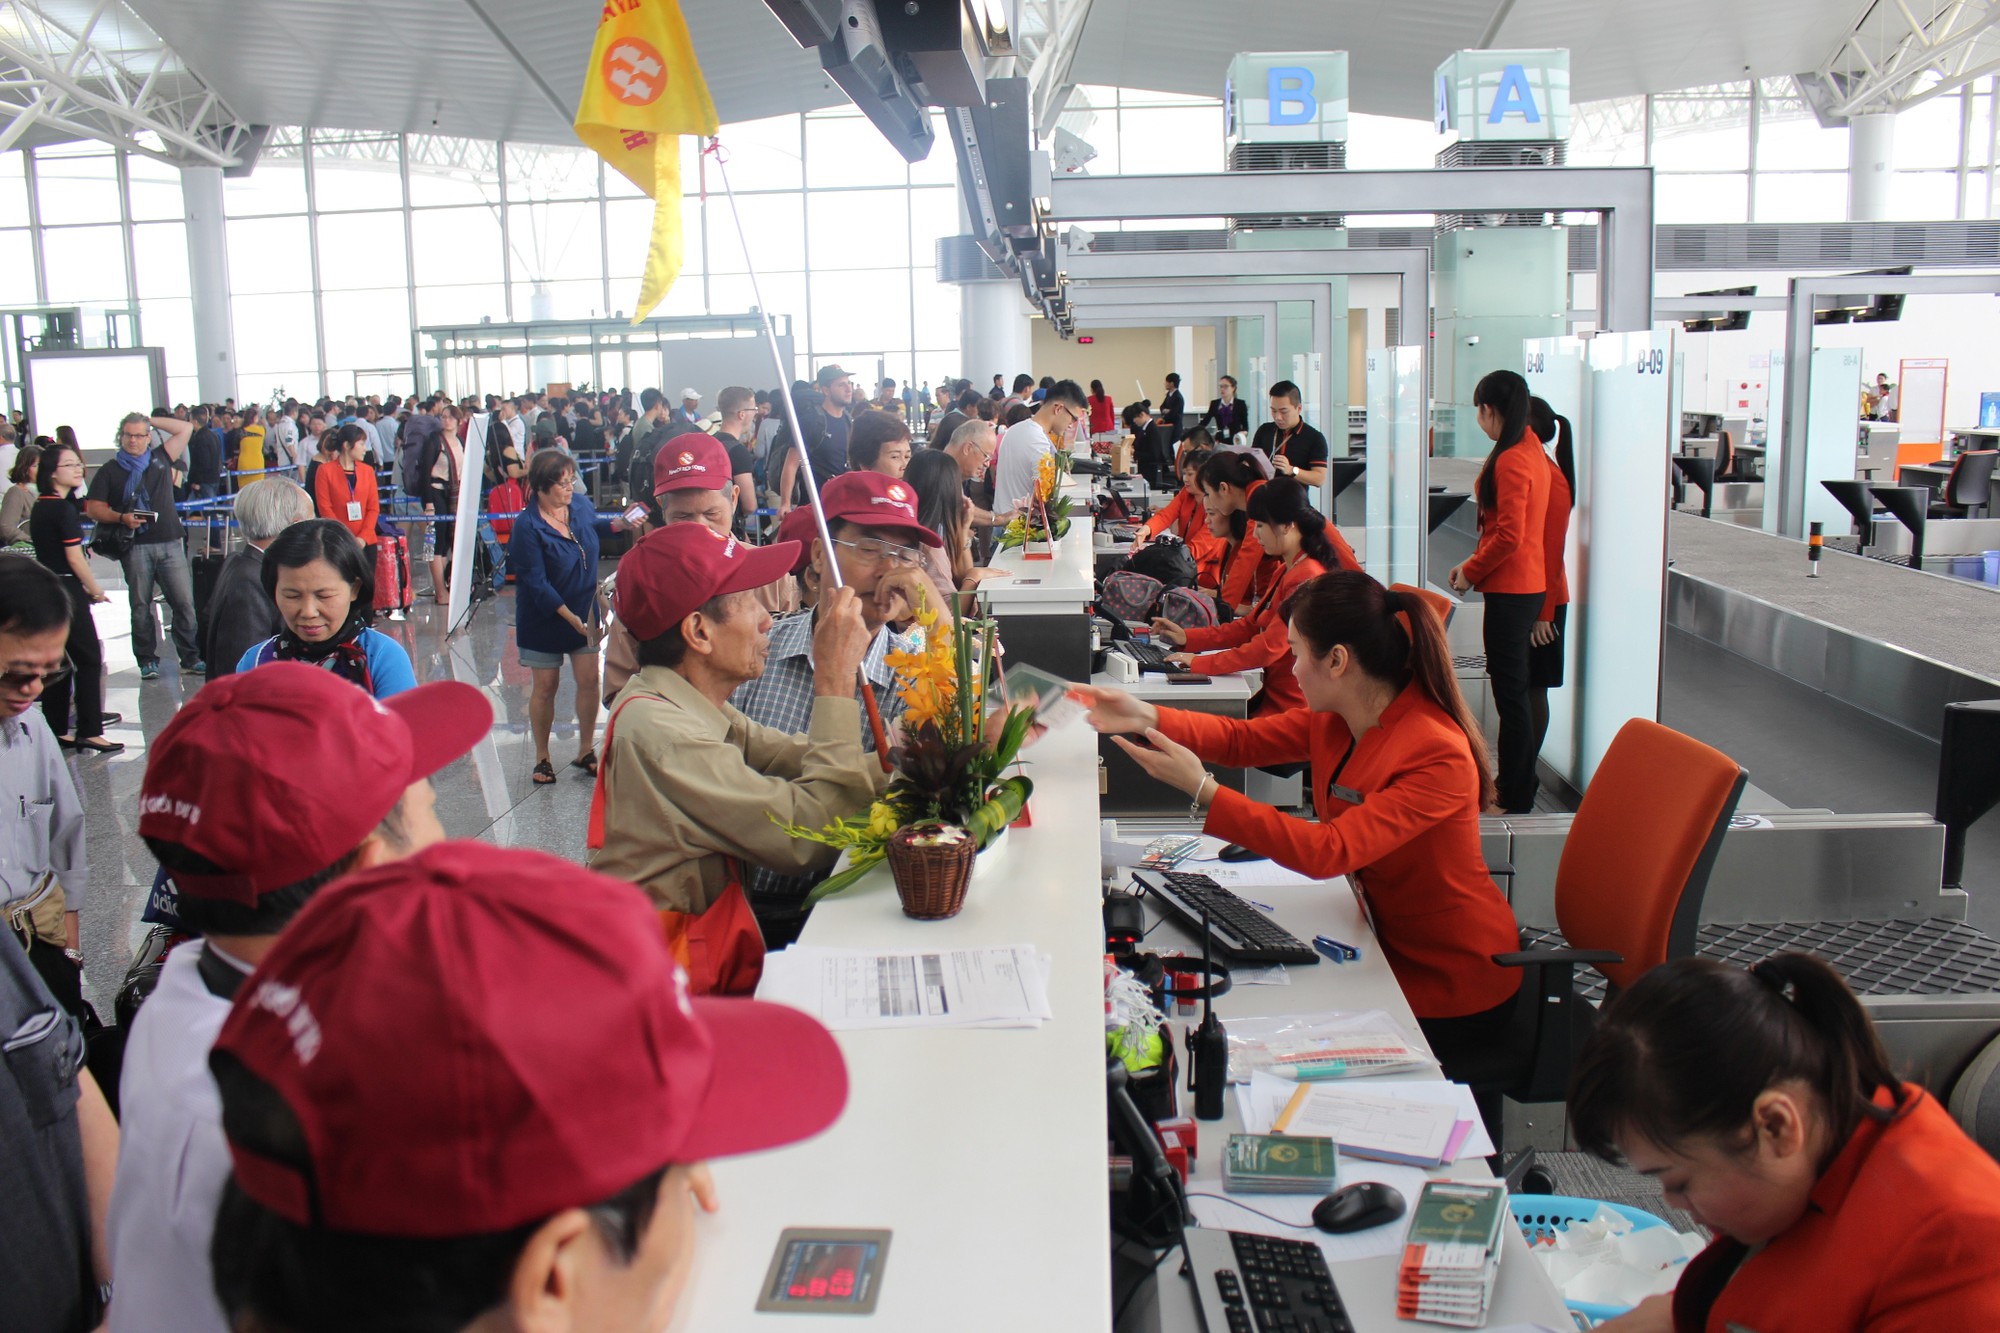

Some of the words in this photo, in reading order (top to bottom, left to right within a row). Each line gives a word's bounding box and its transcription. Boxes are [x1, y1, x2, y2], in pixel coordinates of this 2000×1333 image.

[1268, 67, 1317, 126] B
[1487, 64, 1541, 124] A
[1527, 352, 1544, 374] B-08
[1637, 348, 1664, 375] B-09
